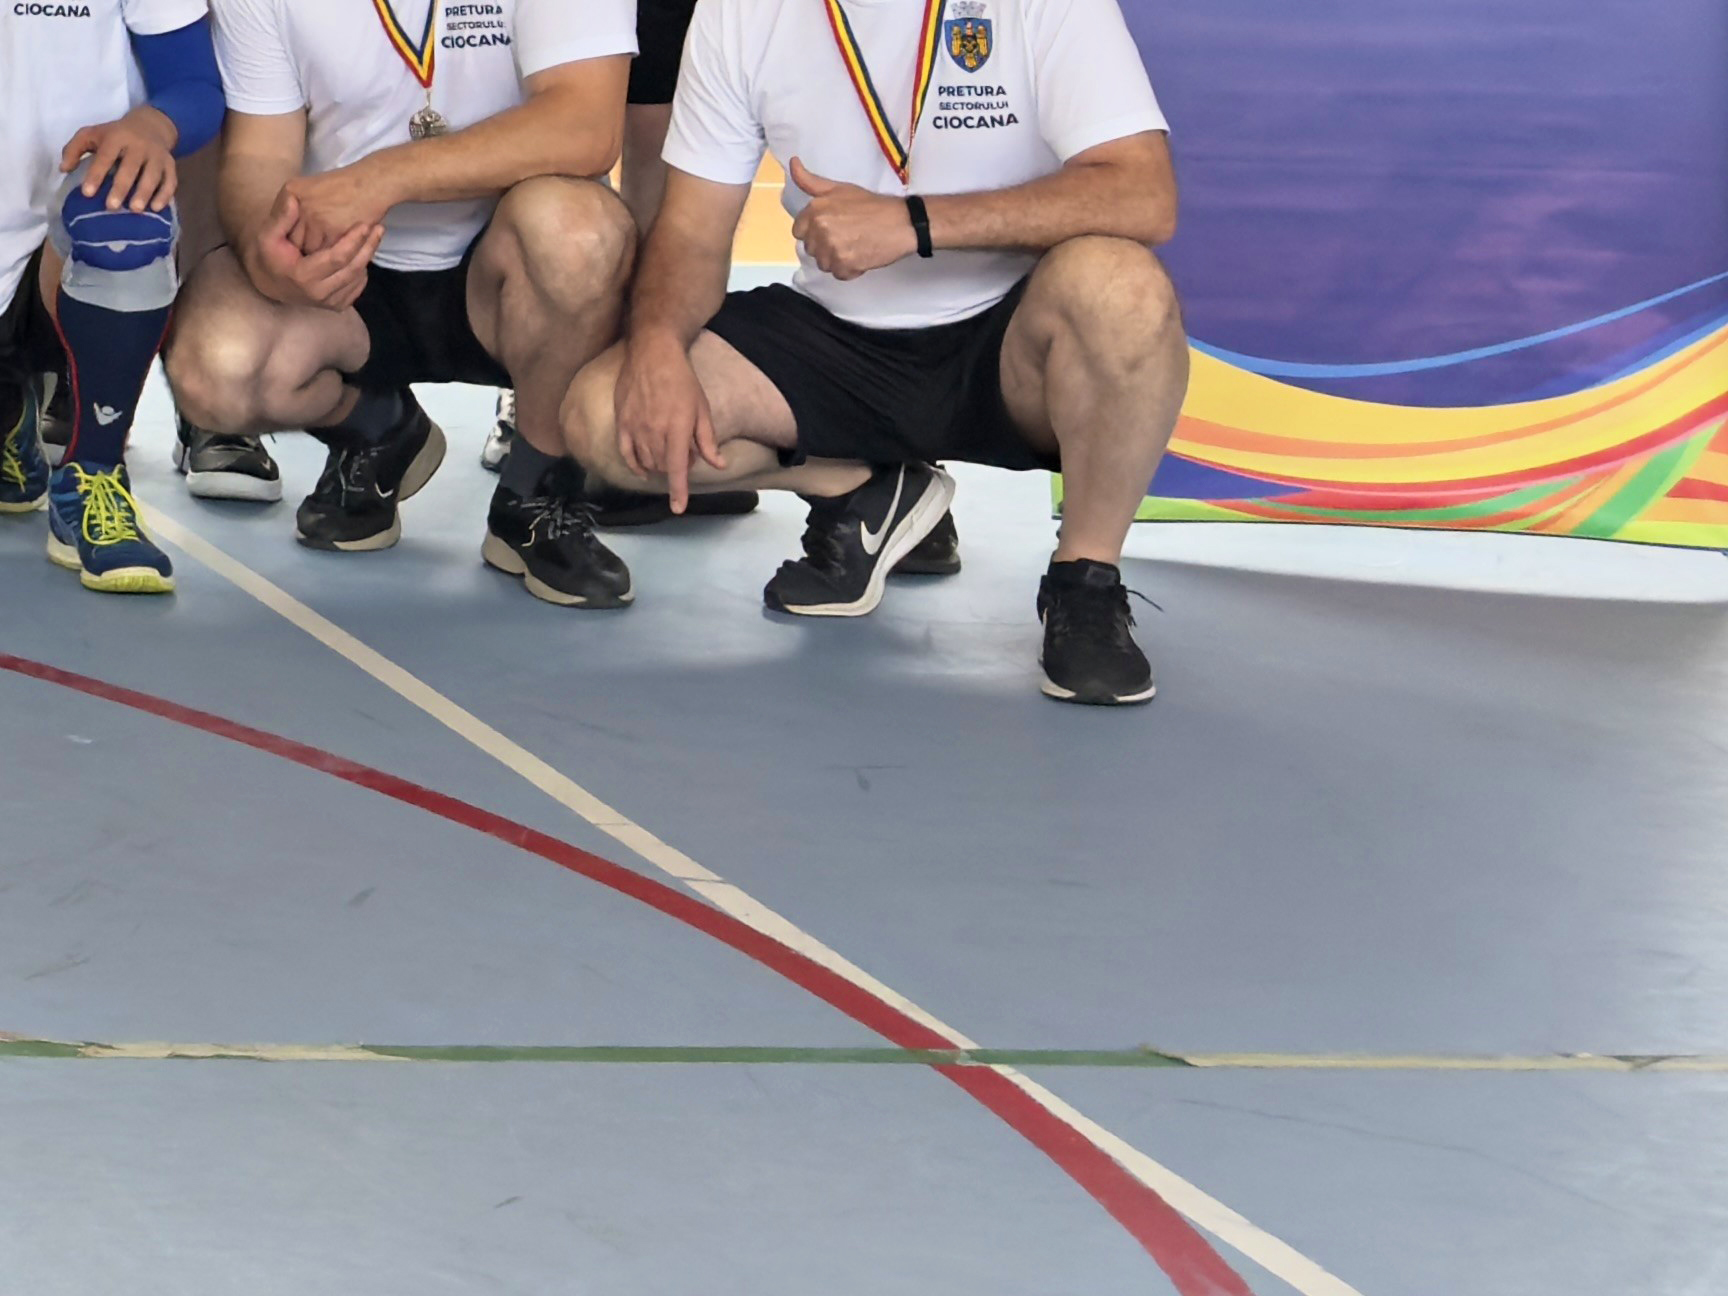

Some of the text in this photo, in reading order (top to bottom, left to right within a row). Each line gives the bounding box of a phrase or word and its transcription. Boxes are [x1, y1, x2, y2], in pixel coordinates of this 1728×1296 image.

[13, 2, 91, 18] CIOCANA
[445, 4, 503, 17] PRETURA
[938, 85, 1007, 97] PRETURA
[939, 101, 1009, 111] SECTORULUI
[932, 112, 1019, 129] CIOCANA
